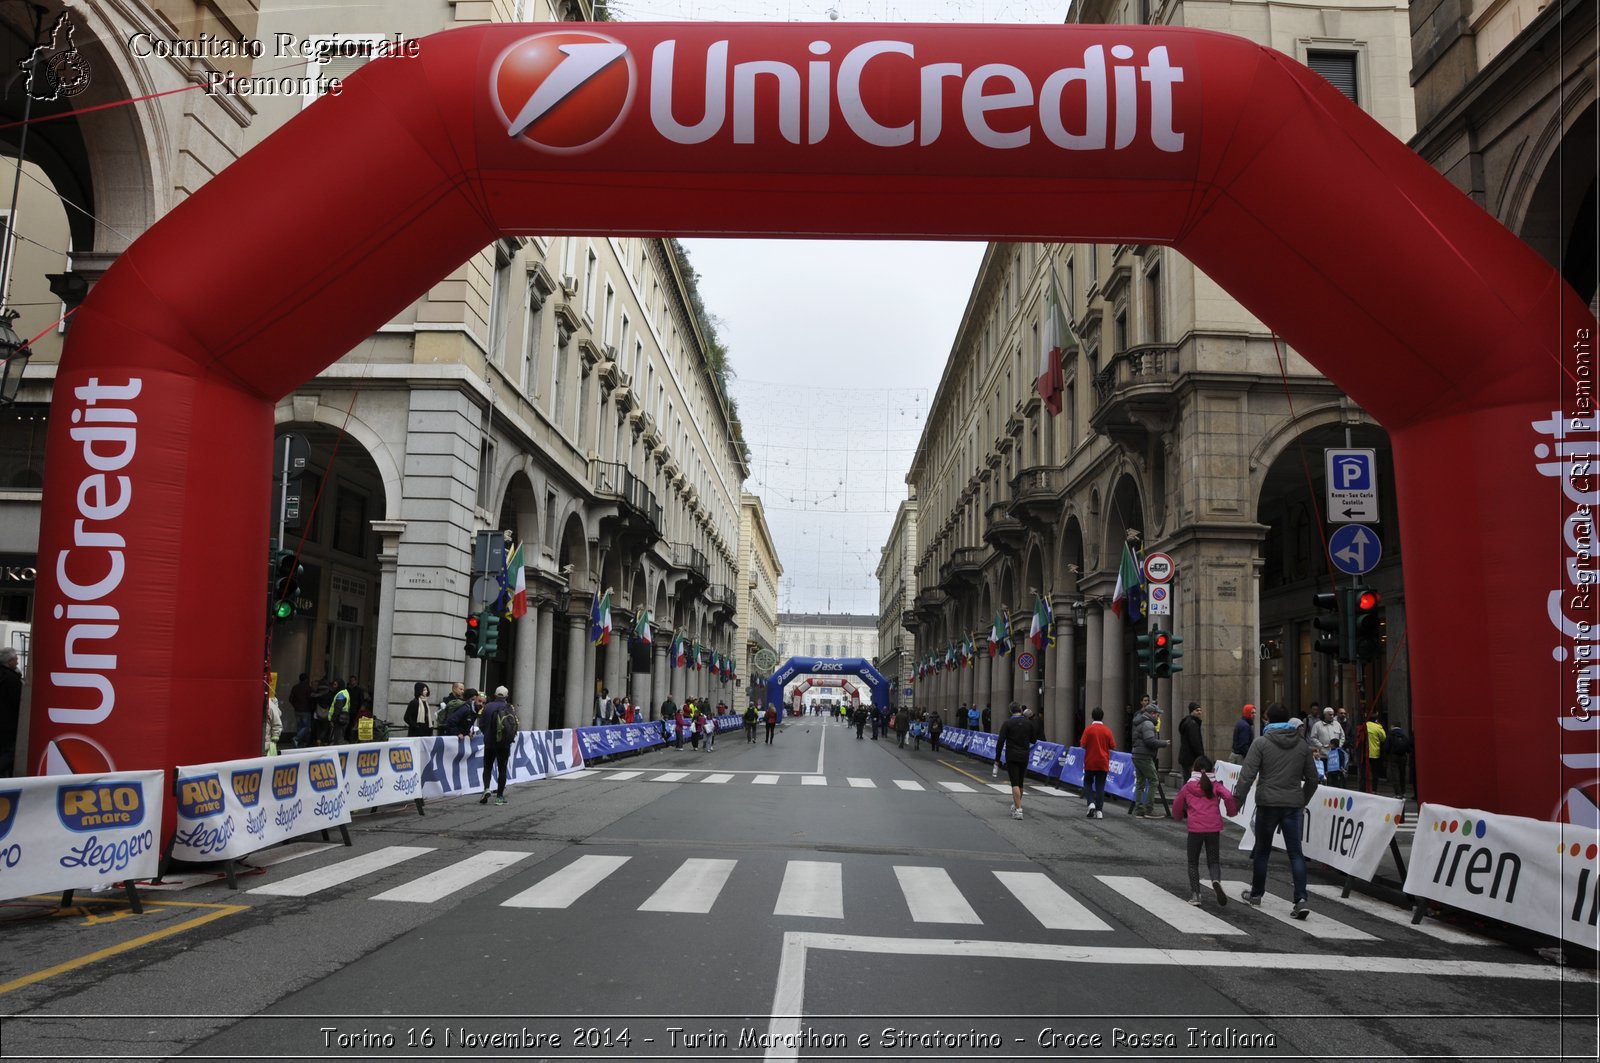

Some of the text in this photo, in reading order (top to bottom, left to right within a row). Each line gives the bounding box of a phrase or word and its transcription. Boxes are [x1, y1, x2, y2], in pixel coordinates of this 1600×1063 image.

[649, 39, 1185, 153] UniCredit
[1343, 464, 1361, 488] P
[48, 377, 142, 725] UniCredit
[390, 749, 412, 764] RIO
[233, 772, 260, 795] RIO
[273, 767, 297, 788] RIO
[310, 763, 336, 782] RIO
[64, 787, 139, 816] RIO
[182, 779, 222, 806] RIO
[81, 812, 131, 826] mare
[195, 801, 221, 815] mare
[1329, 814, 1364, 859] iren
[60, 829, 153, 874] Leggero
[1433, 840, 1522, 904] iren
